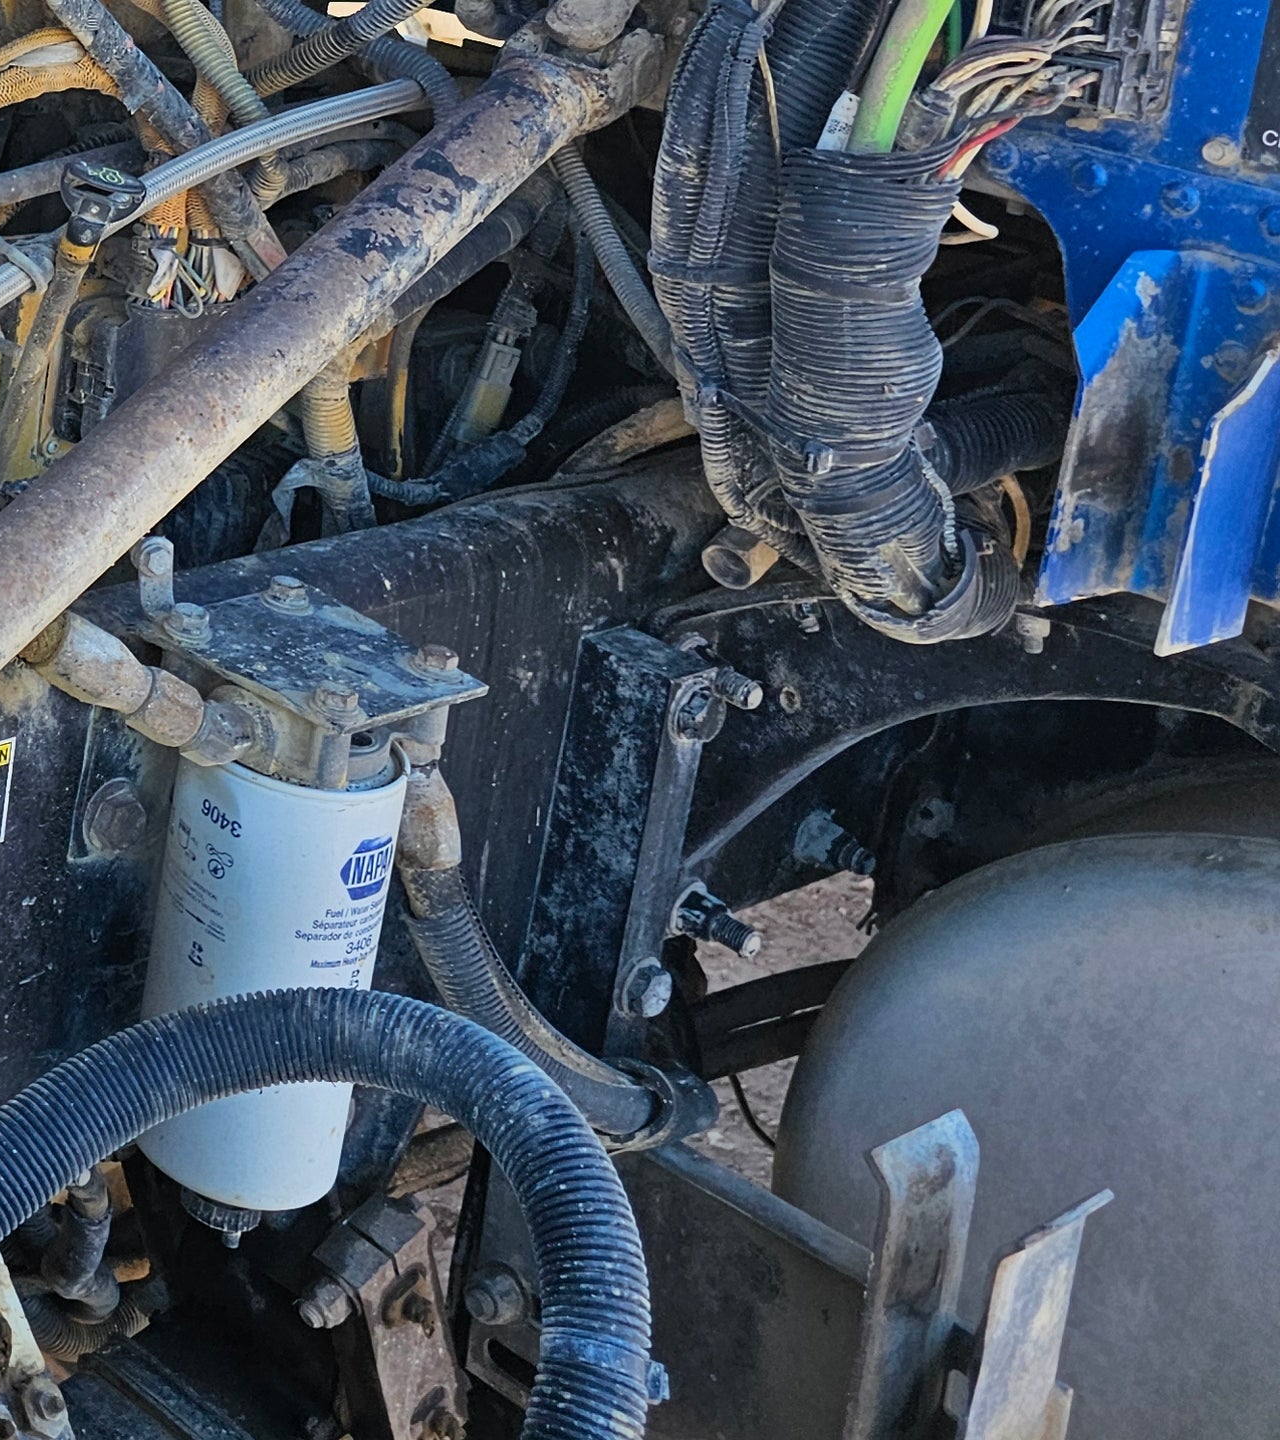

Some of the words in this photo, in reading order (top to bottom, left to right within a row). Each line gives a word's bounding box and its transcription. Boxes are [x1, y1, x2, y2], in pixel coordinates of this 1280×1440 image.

[201, 798, 243, 839] 3406
[325, 908, 344, 919] Fuel
[294, 929, 342, 943] Separador
[345, 933, 373, 955] 3406
